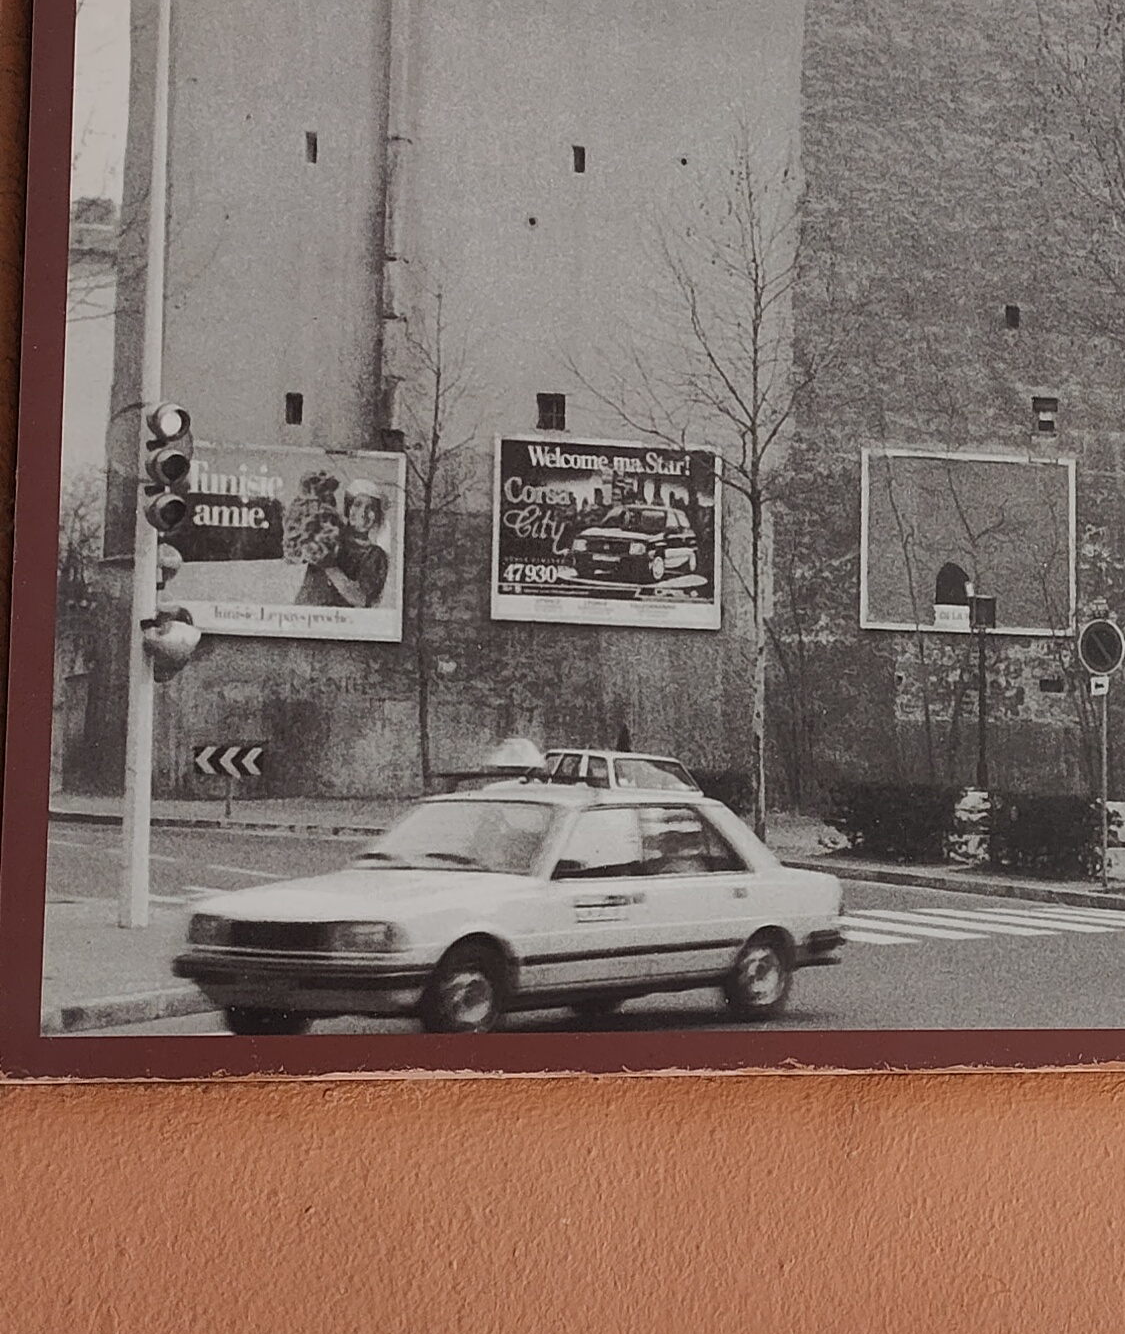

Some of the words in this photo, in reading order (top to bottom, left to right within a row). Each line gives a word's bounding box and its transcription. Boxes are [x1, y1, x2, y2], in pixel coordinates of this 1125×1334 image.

[527, 445, 609, 471] Welcome
[645, 452, 692, 477] Star!
[504, 476, 572, 506] Corsa
[503, 505, 569, 556] City
